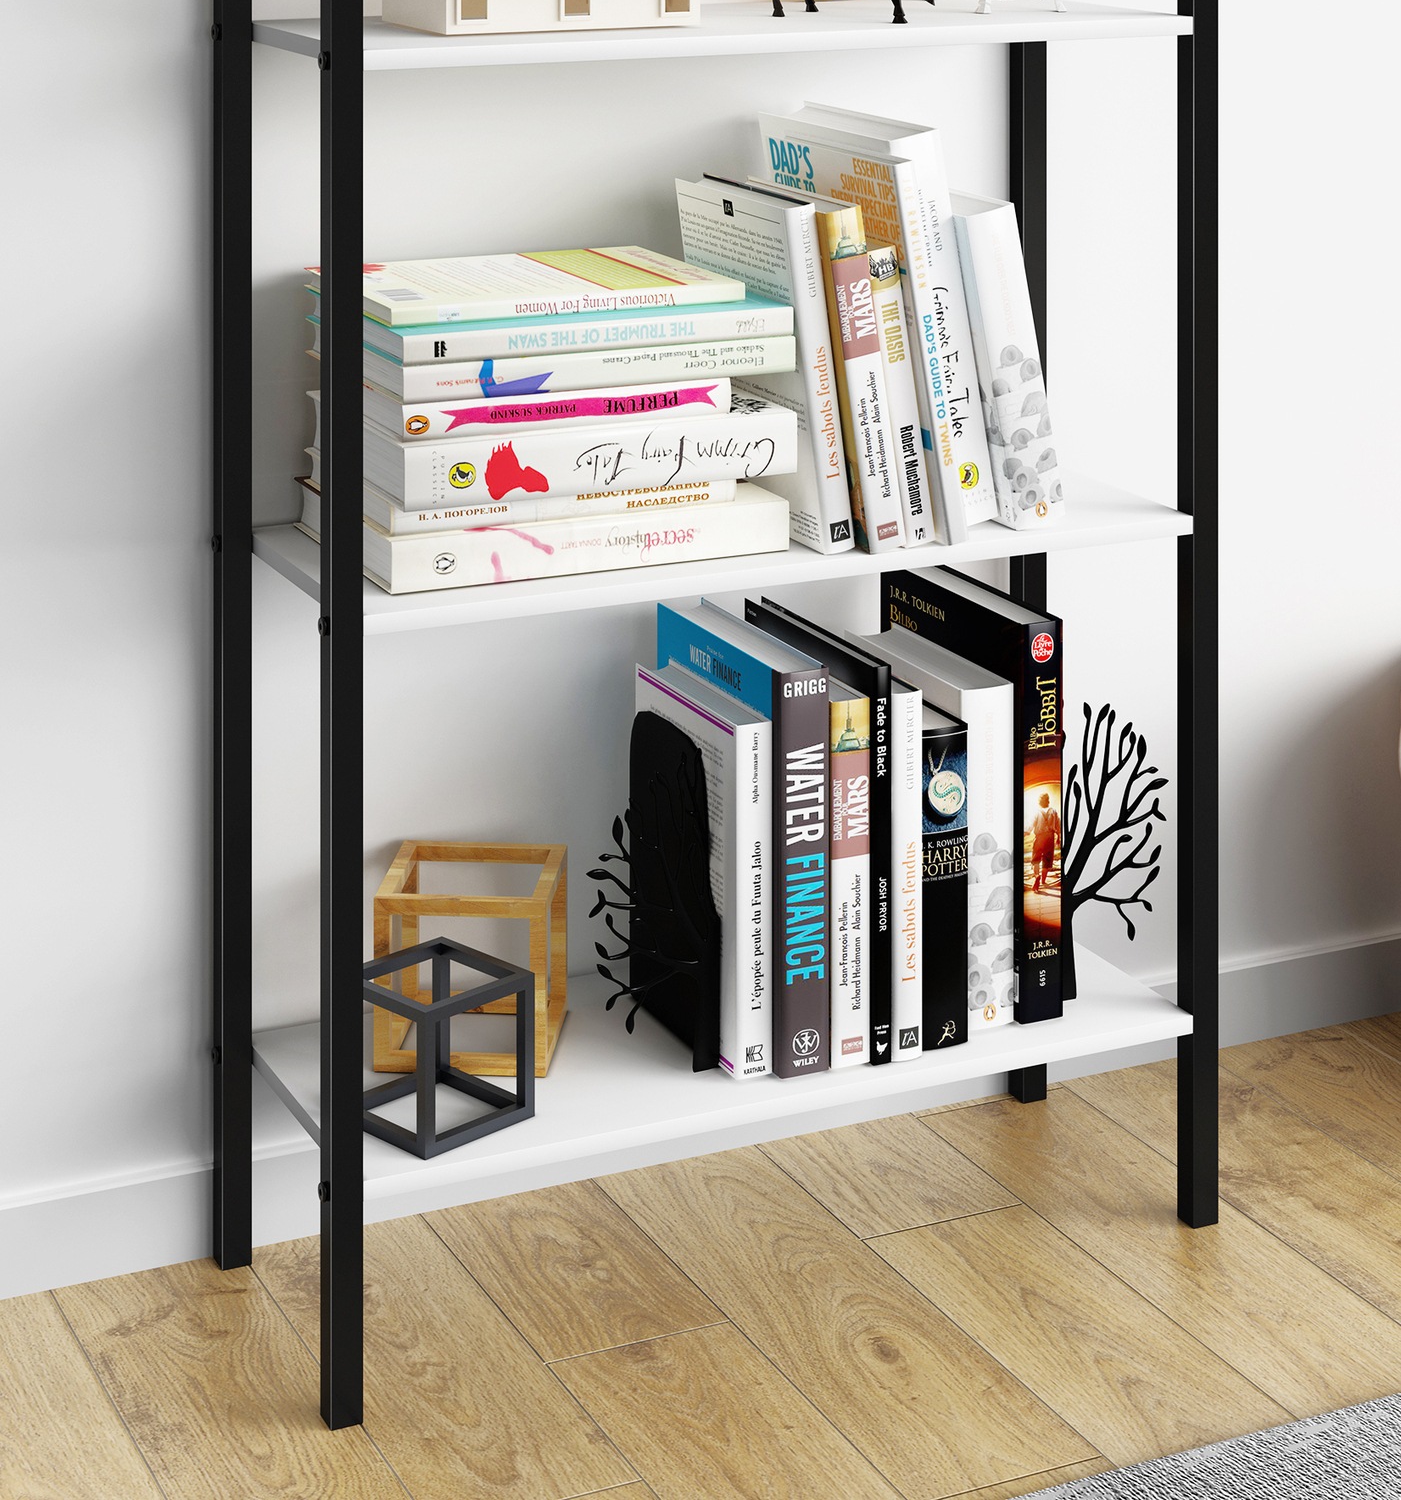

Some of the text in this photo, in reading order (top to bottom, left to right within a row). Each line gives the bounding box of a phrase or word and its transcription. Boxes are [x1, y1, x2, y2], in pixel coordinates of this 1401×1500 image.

[768, 137, 814, 180] DAD'S
[852, 157, 894, 183] ESSENTIAL
[840, 173, 895, 203] SURVIVAL TIPS
[865, 218, 901, 242] ATHER OF
[927, 200, 943, 252] JACOB AND
[805, 256, 817, 298] GILBERT
[515, 293, 676, 315] Victorious Living For Women
[850, 278, 877, 340] MARS
[881, 300, 900, 324] THE
[508, 321, 696, 350] THE TRUMPET OF THE SWAN
[736, 344, 765, 352] Sadako
[884, 324, 906, 364] OASIS
[602, 356, 631, 364] Cranes
[633, 353, 657, 363] Paper
[660, 349, 699, 361] Thousand
[683, 357, 765, 370] Eleonor Coerr
[702, 348, 718, 357] The
[436, 379, 454, 387] Sons
[922, 315, 954, 467] DAD'S GUIDE TO TWINS
[490, 403, 576, 420] PATRICK SUSKIND
[603, 391, 679, 414] PERFUME
[813, 346, 841, 481] Les sabots fendus
[858, 397, 876, 477] Jean-François Pellerin
[867, 371, 892, 499] Richard Heidmann Alain Souchier
[900, 424, 923, 517] Robert Muchamore
[431, 512, 442, 520] А.
[444, 505, 509, 519] ПОГОРЕЛОВ
[626, 493, 710, 509] НАСЛЕДСТВО
[889, 584, 945, 622] J.R.R. TOLKIEN
[689, 643, 712, 674] WATER
[712, 658, 742, 691] FINANCE
[783, 677, 827, 699] GRIGG
[1035, 676, 1057, 750] HOBBIT
[876, 697, 887, 778] Fade to Black
[906, 696, 914, 790] GILBERT MERCIER
[1028, 726, 1037, 751] BILBO
[751, 732, 760, 804] Alpha Ousmane Barry
[847, 775, 870, 839] MARS
[922, 843, 969, 864] HARRY
[936, 834, 968, 848] ROWLING
[786, 743, 825, 986] WATER FINANCE
[922, 857, 968, 877] POTTER
[878, 876, 888, 932] JOSH PRYOR
[901, 840, 916, 983] Les sabots fendus
[751, 841, 765, 1011] L'épopée peule du Fuuta Jaloo
[838, 901, 850, 987] Jean-François Pellerin
[851, 874, 861, 1011] Richard Heidmann Alain Souchier
[1028, 947, 1058, 960] TOLKIEN
[1032, 940, 1053, 951] J.R.R.
[792, 1055, 819, 1068] WILEY
